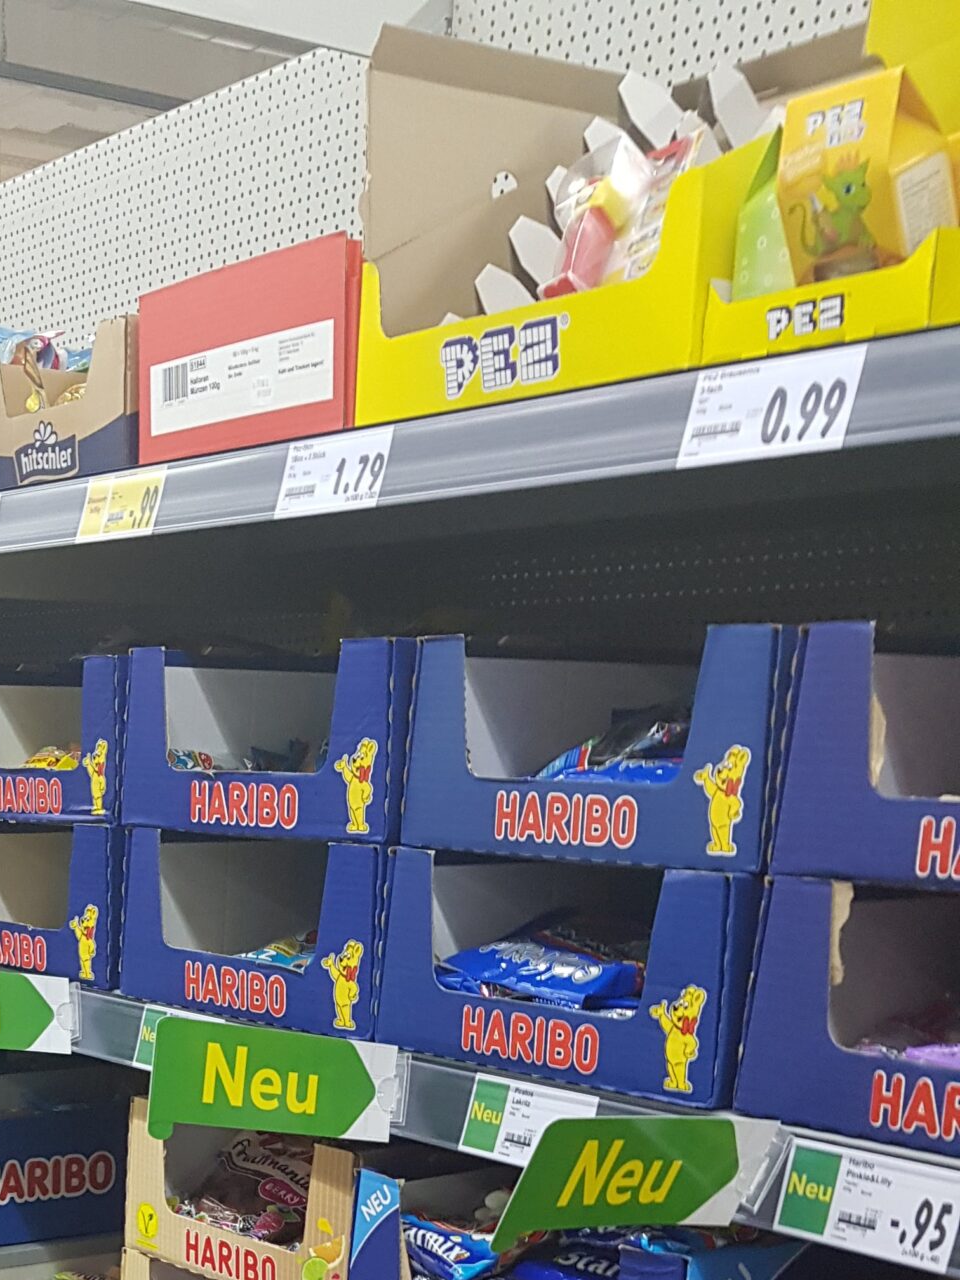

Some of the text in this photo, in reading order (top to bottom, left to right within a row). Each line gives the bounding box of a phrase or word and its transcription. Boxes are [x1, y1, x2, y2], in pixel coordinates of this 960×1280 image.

[806, 98, 865, 136] PEZ
[766, 294, 846, 341] PEZ
[441, 316, 562, 400] PEZ
[760, 377, 848, 445] 0.99
[20, 445, 73, 476] hitschler
[332, 451, 385, 495] 1.79
[189, 780, 300, 830] HARIBO
[493, 790, 639, 850] HARIBO
[183, 960, 287, 1018] HARIBO
[141, 1025, 156, 1043] Ne
[460, 1003, 600, 1075] HARIBO
[202, 1041, 319, 1116] Neu
[471, 1101, 502, 1125] Neu
[869, 1068, 960, 1142] HAR
[556, 1139, 683, 1209] Neu
[849, 1157, 875, 1169] Haribo
[264, 1183, 300, 1204] BERRY
[360, 1184, 392, 1222] NEU
[787, 1171, 834, 1203] Neu
[402, 1223, 471, 1262] armix
[890, 1198, 953, 1252] -.95
